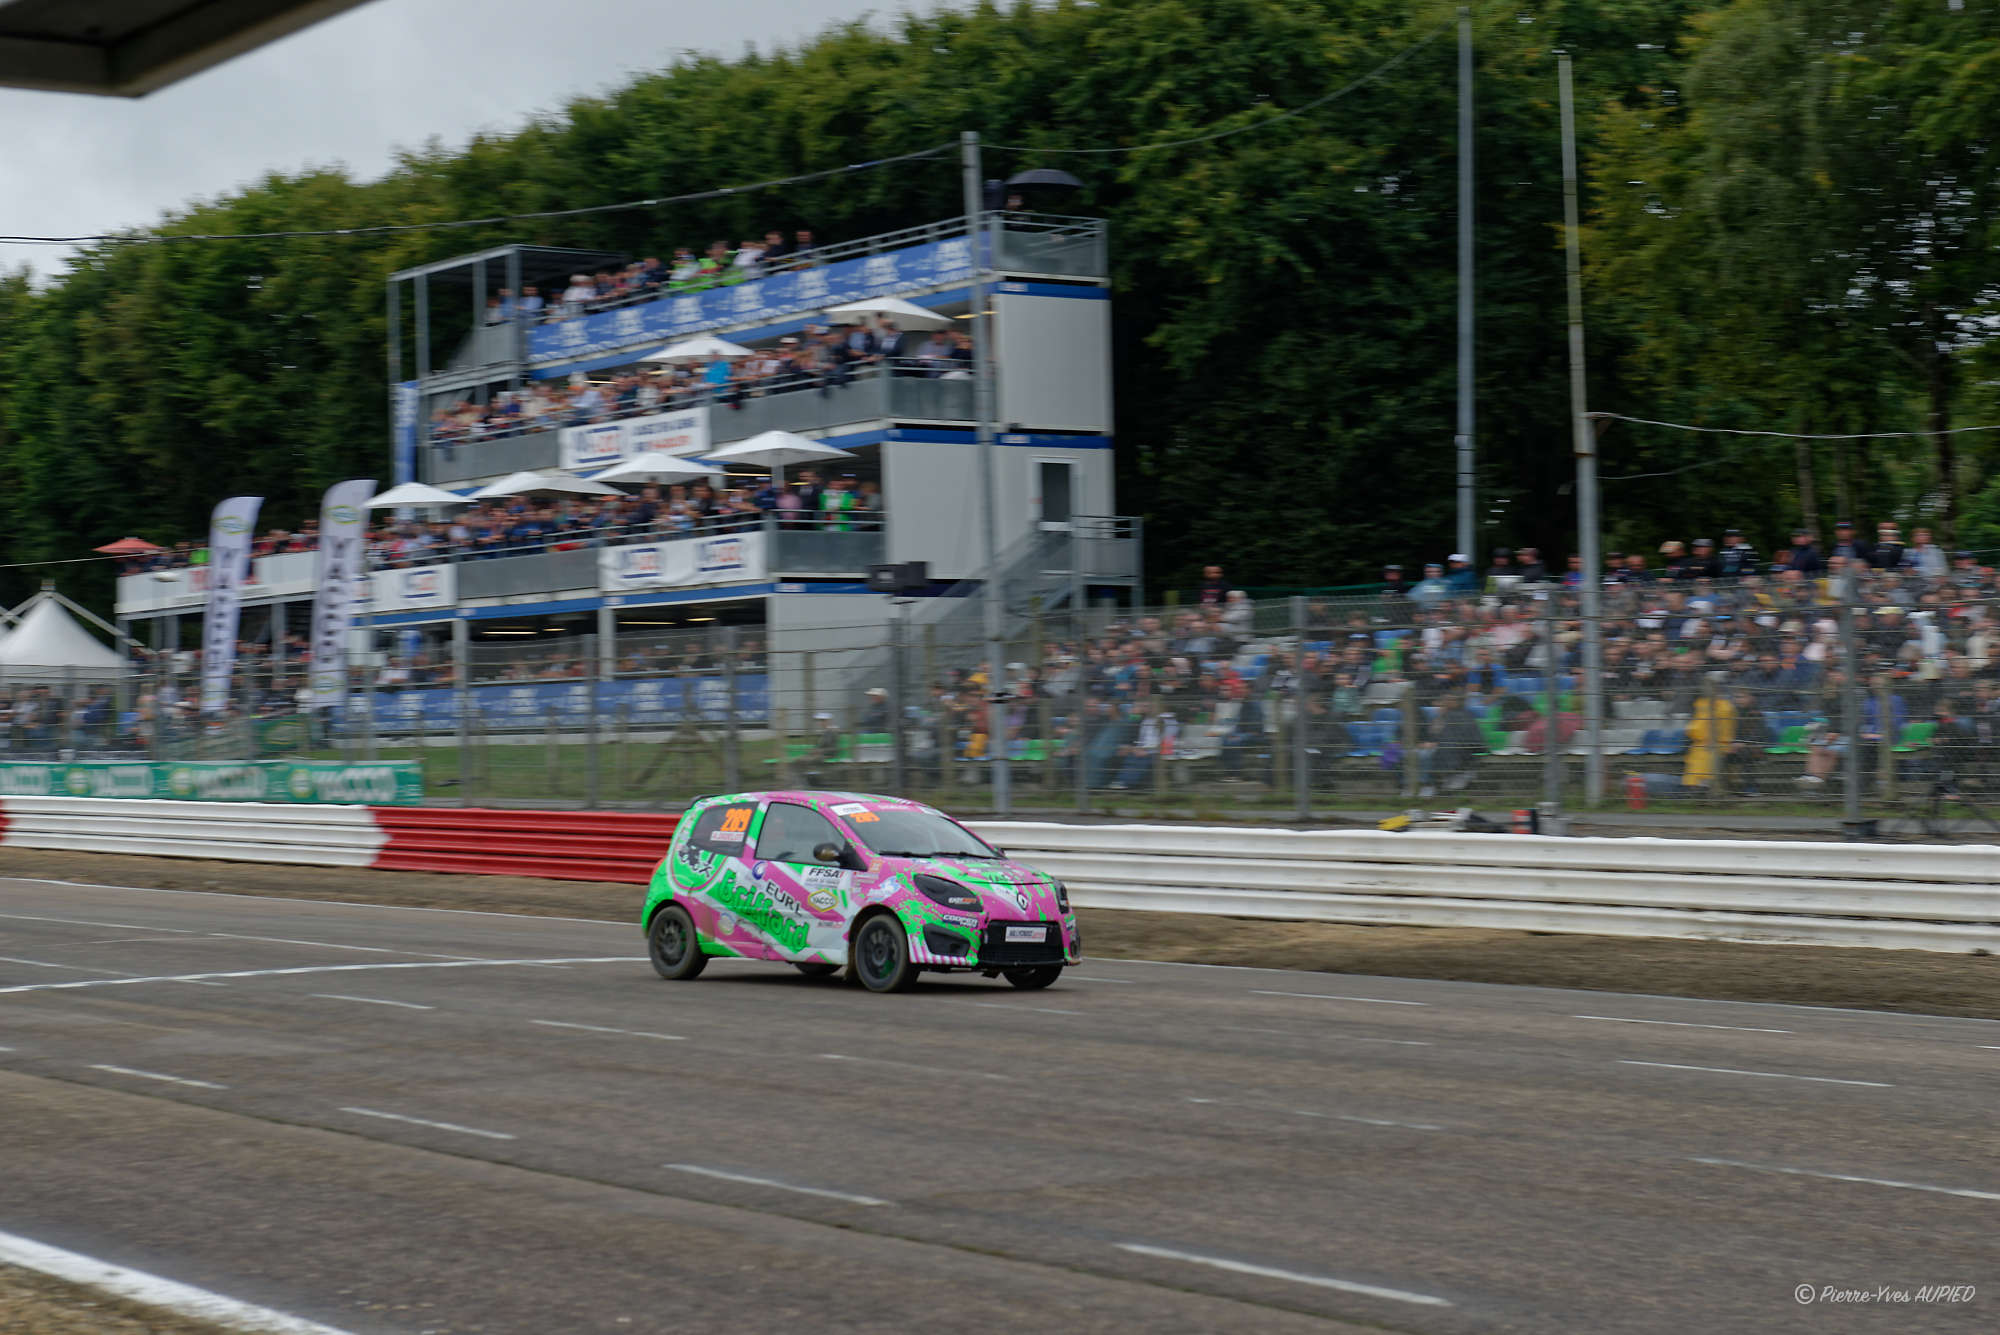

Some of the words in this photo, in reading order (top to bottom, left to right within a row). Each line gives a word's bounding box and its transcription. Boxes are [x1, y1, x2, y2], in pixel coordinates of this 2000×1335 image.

[720, 808, 753, 832] 289
[808, 867, 840, 878] FFSA
[766, 880, 803, 917] EURL
